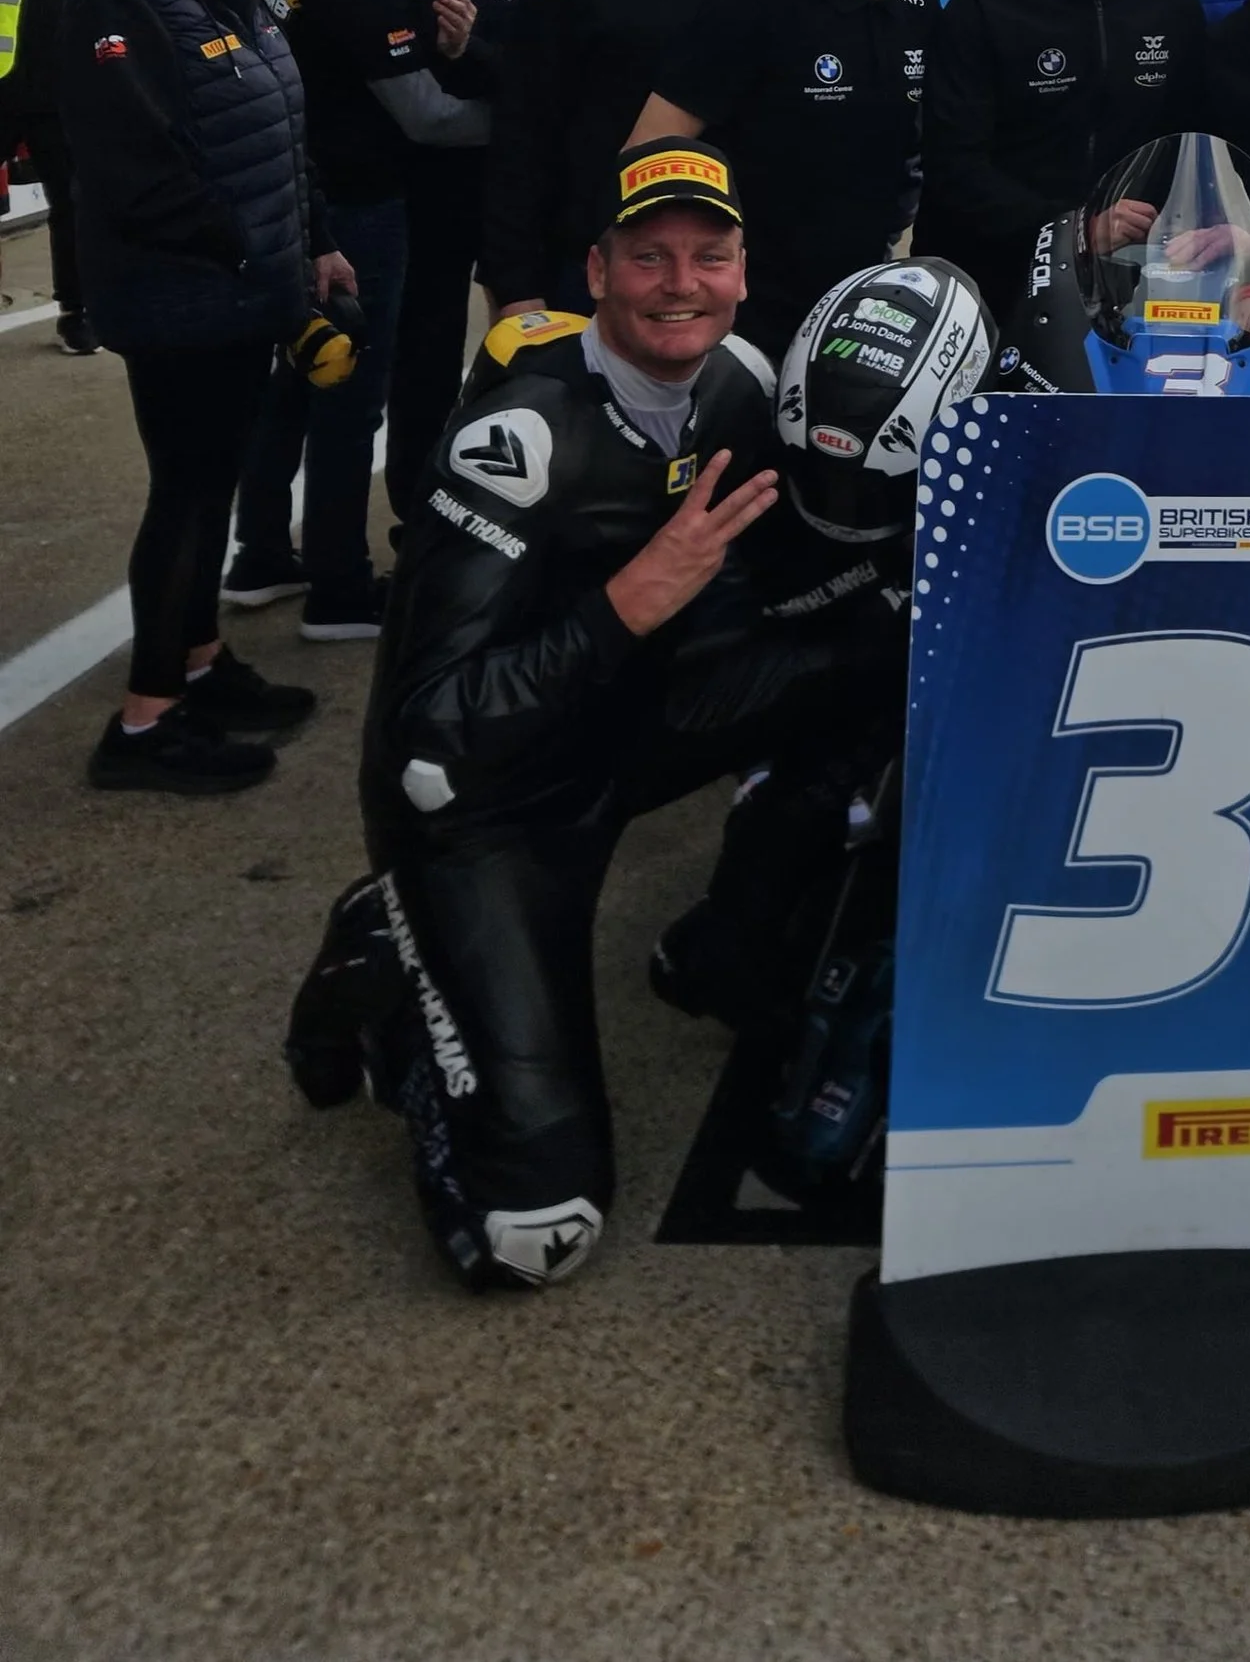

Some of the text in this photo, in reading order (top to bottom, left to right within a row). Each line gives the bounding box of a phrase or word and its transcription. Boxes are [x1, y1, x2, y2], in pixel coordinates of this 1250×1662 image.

[1137, 73, 1167, 83] alpha
[626, 157, 722, 191] PIRELLI
[802, 289, 840, 338] LOOPS
[869, 303, 915, 328] MODE
[1152, 305, 1211, 320] PIRELLI
[848, 319, 912, 348] John Darke
[857, 344, 905, 370] MMB
[930, 321, 965, 381] LOOPS
[1020, 361, 1060, 394] Motorrad
[816, 431, 854, 452] BELL
[428, 488, 527, 559] FRANK THOMAS
[1056, 515, 1144, 542] BSB
